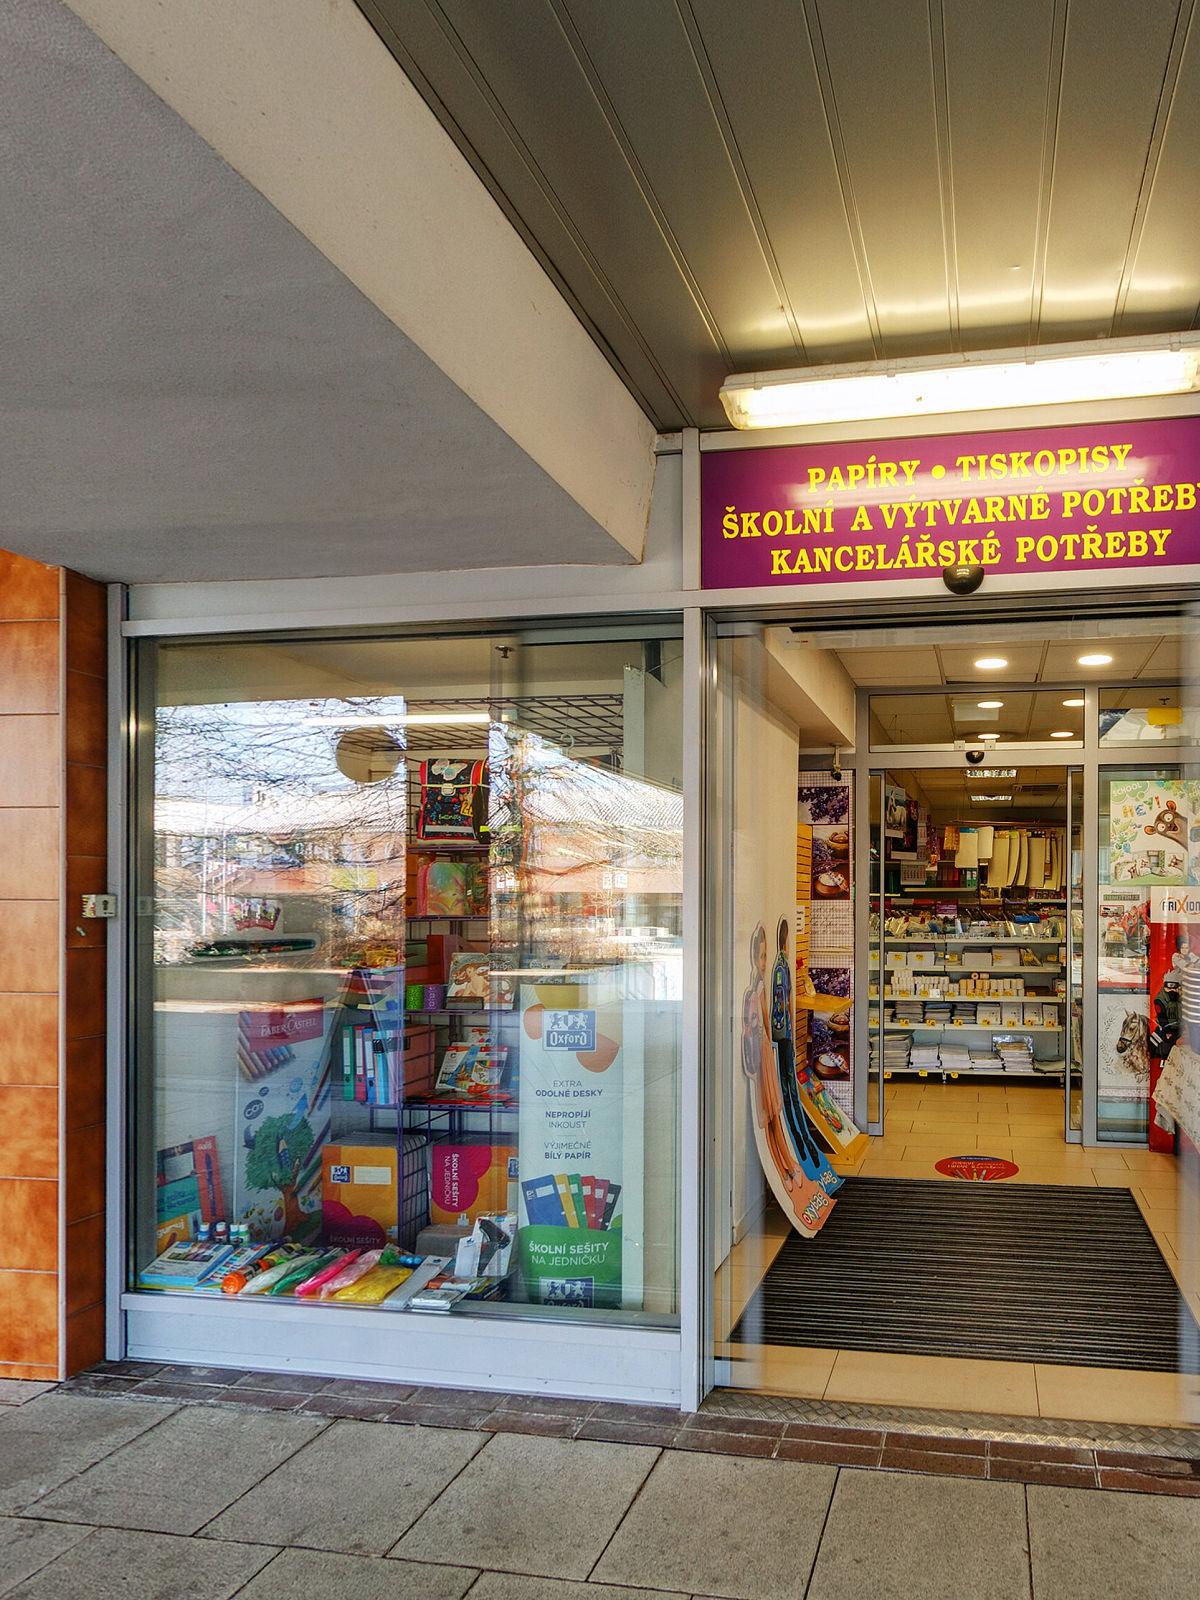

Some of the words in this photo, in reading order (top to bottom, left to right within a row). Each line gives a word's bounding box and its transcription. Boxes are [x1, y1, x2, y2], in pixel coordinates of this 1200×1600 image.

[807, 455, 921, 494] PAPÍRY
[956, 444, 1133, 483] TISKOPISY
[722, 500, 835, 539] ŠKOLNÍ
[850, 506, 873, 532] A
[879, 485, 1051, 529] VÝTVARNÉ
[770, 530, 1002, 575] KANCELÁŘSKÉ
[1015, 524, 1172, 563] POTŘEBY
[1112, 782, 1142, 798] SCHOOL
[550, 1031, 587, 1046] Oxford
[553, 1080, 582, 1088] EXTRA
[535, 1088, 571, 1098] ODOLNÉ
[573, 1089, 603, 1097] DESKY
[545, 1109, 591, 1118] NEPROPÍJÍ
[548, 1121, 587, 1129] INKOUST
[544, 1150, 561, 1160] BÍLÝ
[564, 1151, 591, 1160] PAPÍR
[528, 1240, 567, 1255] ŠKOLNÍ
[569, 1241, 609, 1254] SEŠITY
[531, 1255, 546, 1265] NA
[548, 1254, 607, 1266] JEDNIČKU
